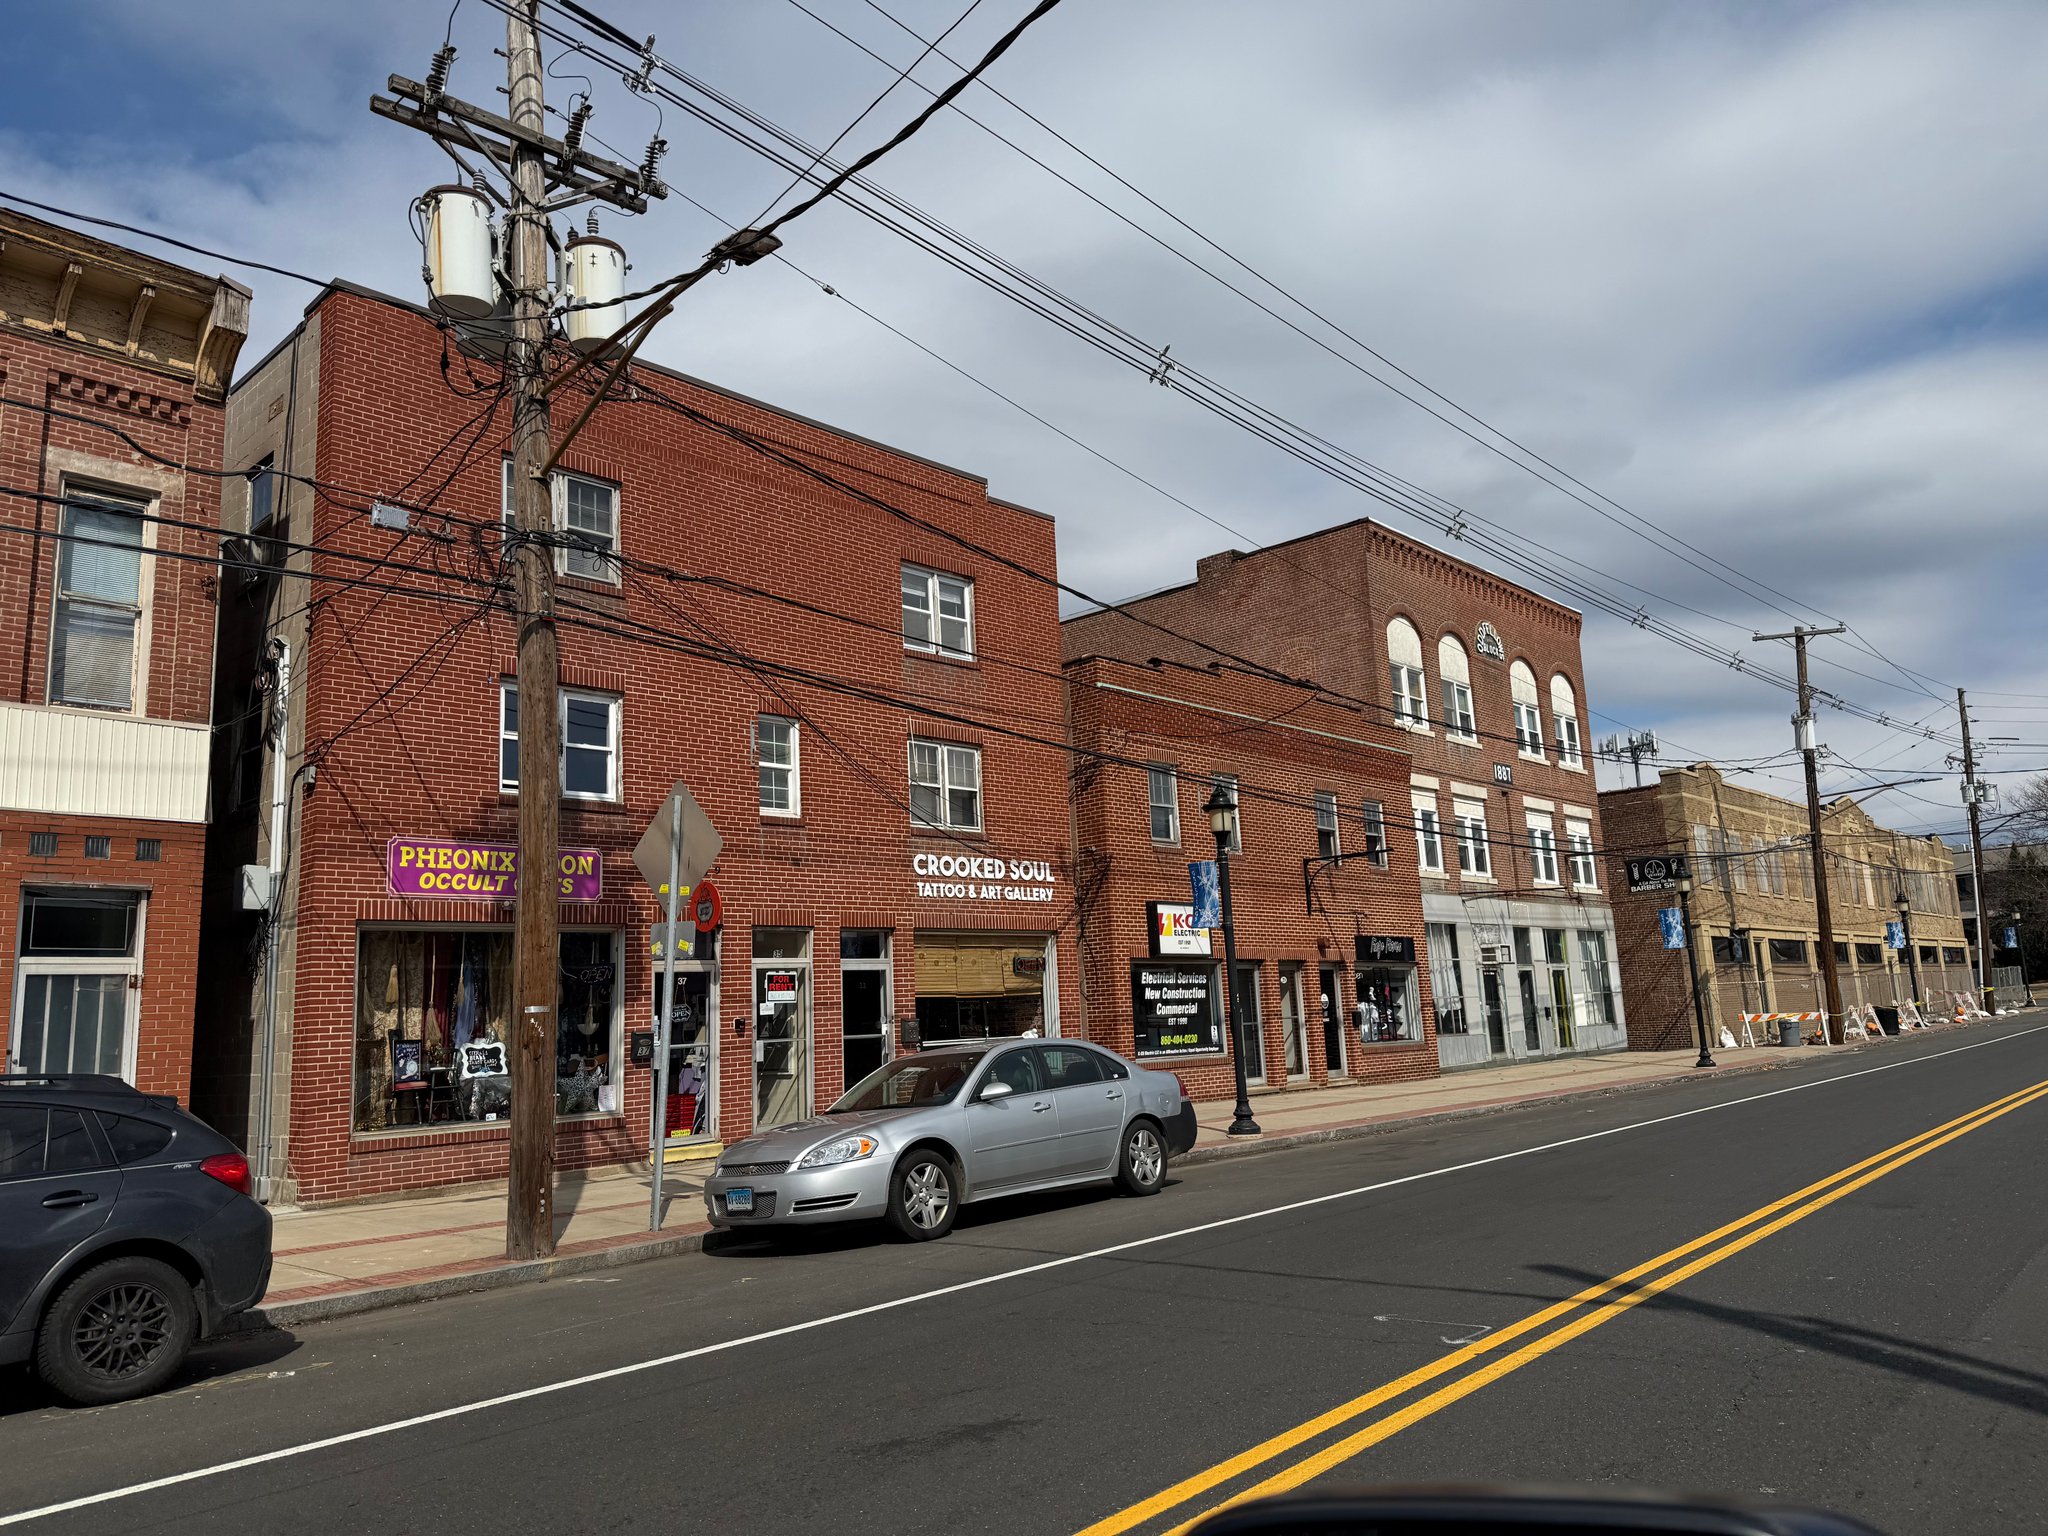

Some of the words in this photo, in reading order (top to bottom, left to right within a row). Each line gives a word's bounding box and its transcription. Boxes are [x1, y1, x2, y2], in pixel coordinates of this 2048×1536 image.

[1494, 765, 1511, 782] 1887
[400, 846, 516, 872] PHEONIX
[913, 853, 1006, 879] CROOKED
[1010, 859, 1055, 882] SOUL
[419, 872, 508, 892] OCCULT
[1630, 883, 1662, 892] BARBER
[917, 882, 965, 898] TATTOO
[968, 884, 977, 898] &
[980, 885, 1002, 900] ART
[1004, 886, 1054, 902] GALLERY
[1174, 929, 1201, 937] ELECTRIC
[677, 977, 687, 985] 37
[1141, 972, 1176, 984] Electrical
[1177, 972, 1207, 984] Services
[769, 983, 794, 991] RENT
[1145, 987, 1161, 1000] New
[1162, 986, 1206, 1000] Construction
[1156, 1002, 1198, 1015] Commercial
